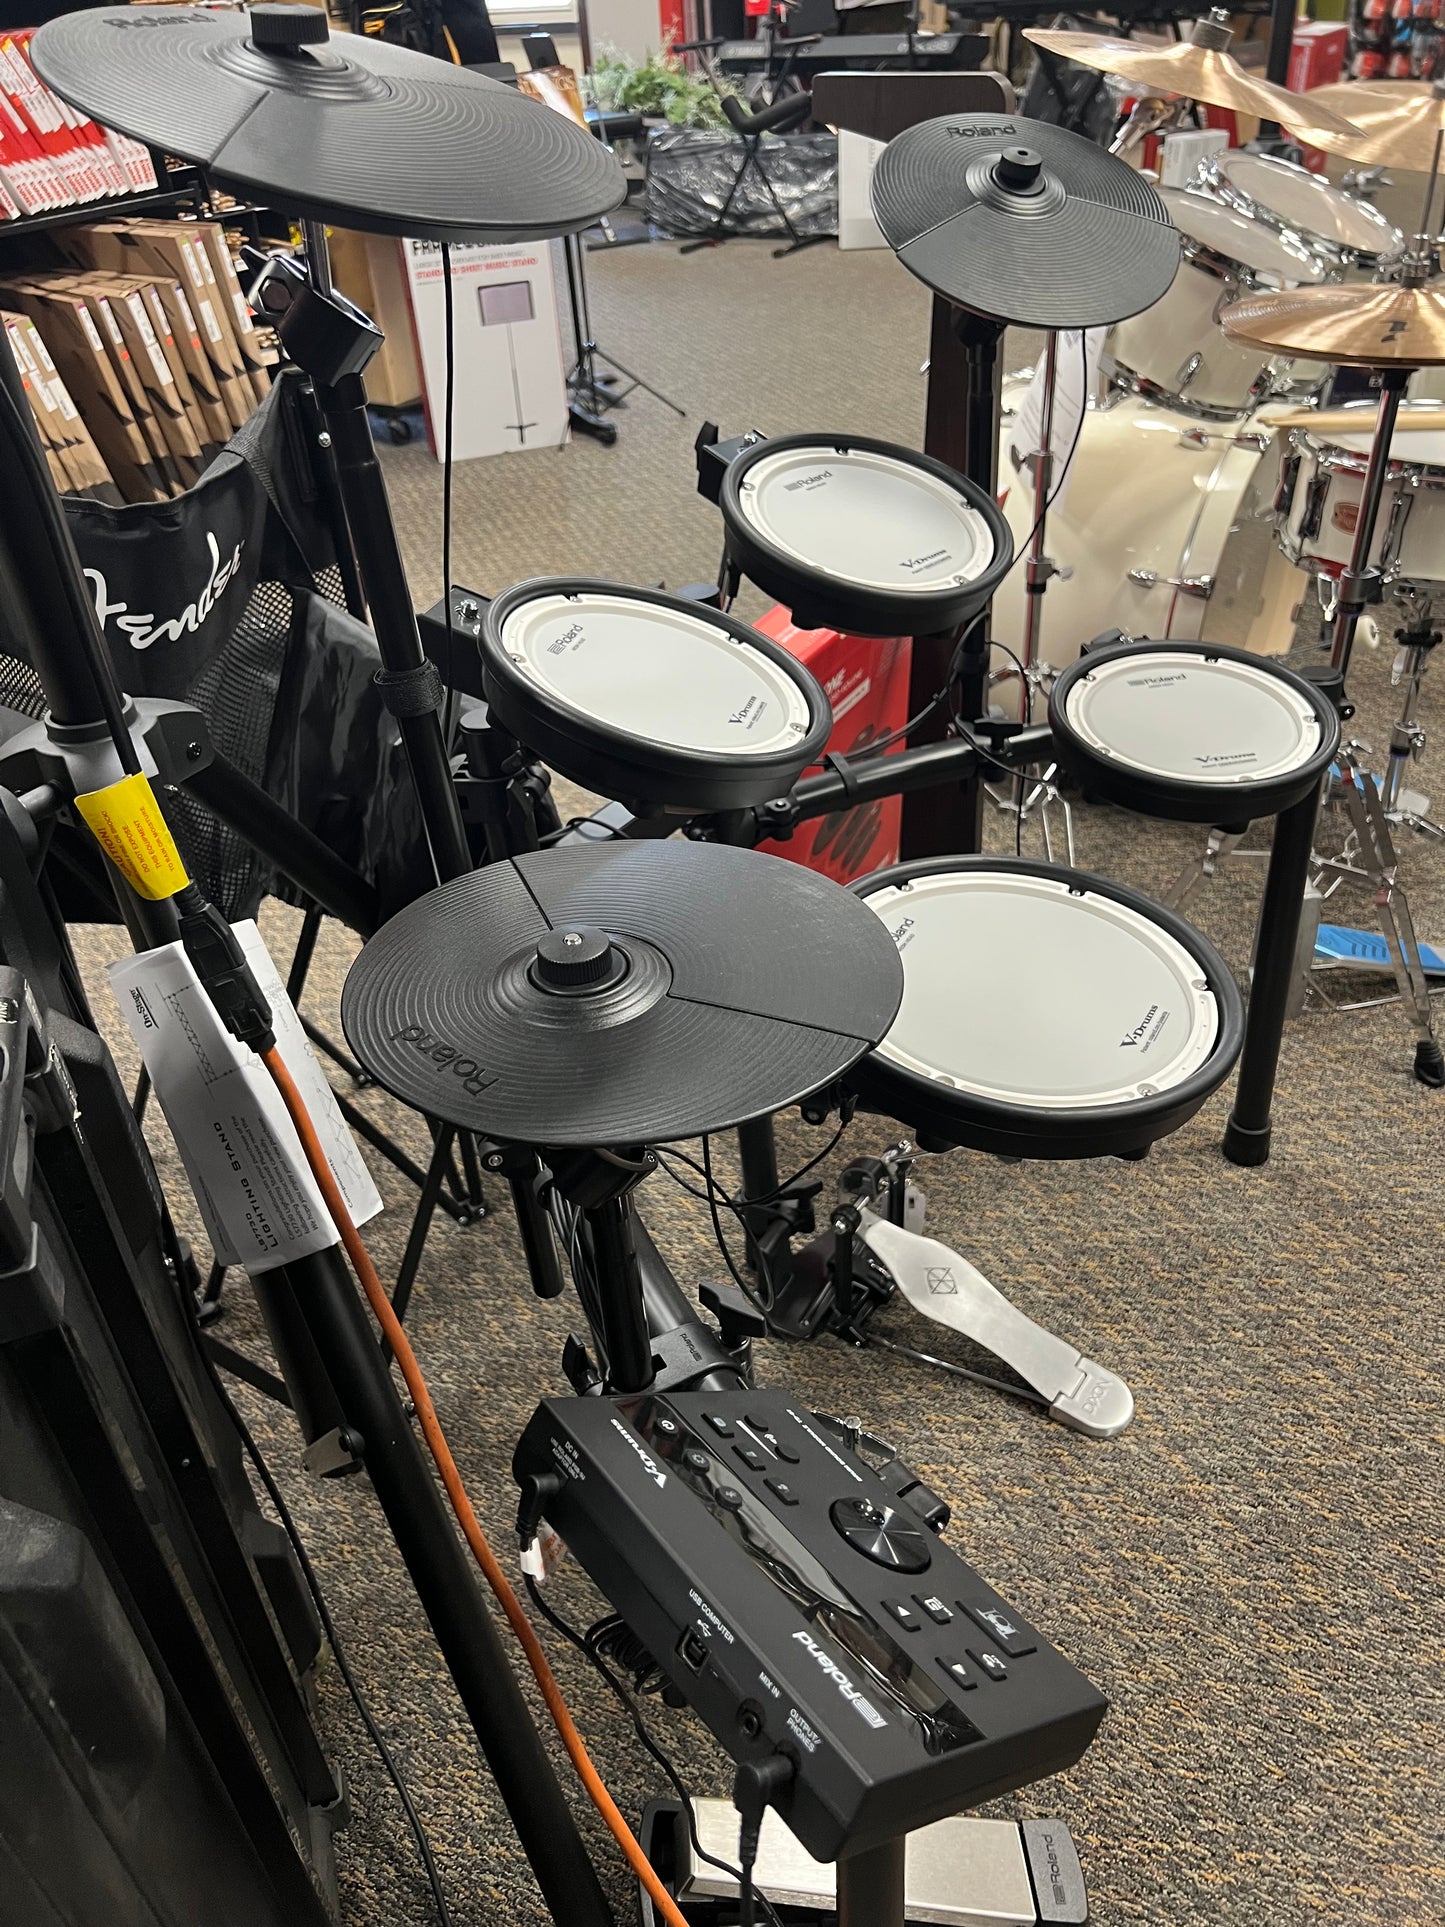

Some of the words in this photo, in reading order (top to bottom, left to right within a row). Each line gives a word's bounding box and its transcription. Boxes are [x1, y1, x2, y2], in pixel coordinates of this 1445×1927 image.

[102, 12, 217, 30] Roland
[944, 124, 1017, 138] Roland
[796, 470, 833, 488] Roland
[554, 623, 583, 648] Roland
[1143, 673, 1187, 685] Roland
[140, 807, 158, 838] MOISTURE
[121, 824, 138, 850] EXPOSE
[134, 820, 154, 854] EQUIPMENT
[155, 837, 163, 847] OR
[134, 849, 145, 863] NOT
[141, 862, 150, 873] DO
[151, 854, 161, 868] THIS
[159, 847, 171, 862] RAIN
[167, 862, 175, 871] TO
[390, 1025, 499, 1097] Roland
[213, 1121, 242, 1172] STAND
[272, 1165, 296, 1204] instructions
[273, 1185, 292, 1213] Lighting
[241, 1178, 278, 1248] LIGHTING
[266, 1189, 296, 1240] Congratulations
[291, 1203, 311, 1234] following
[246, 1212, 268, 1251] LS7730
[680, 1333, 696, 1354] Roland
[564, 1441, 574, 1452] DC
[571, 1450, 579, 1459] IN
[689, 1588, 704, 1607] USB
[700, 1603, 735, 1645] COMPUTER
[792, 1631, 863, 1700] Roland
[759, 1671, 773, 1690] MIX
[770, 1685, 781, 1698] IN
[786, 1717, 815, 1753] PHONES
[790, 1708, 822, 1745] OUTPUT/
[1042, 1834, 1062, 1884] Roland
